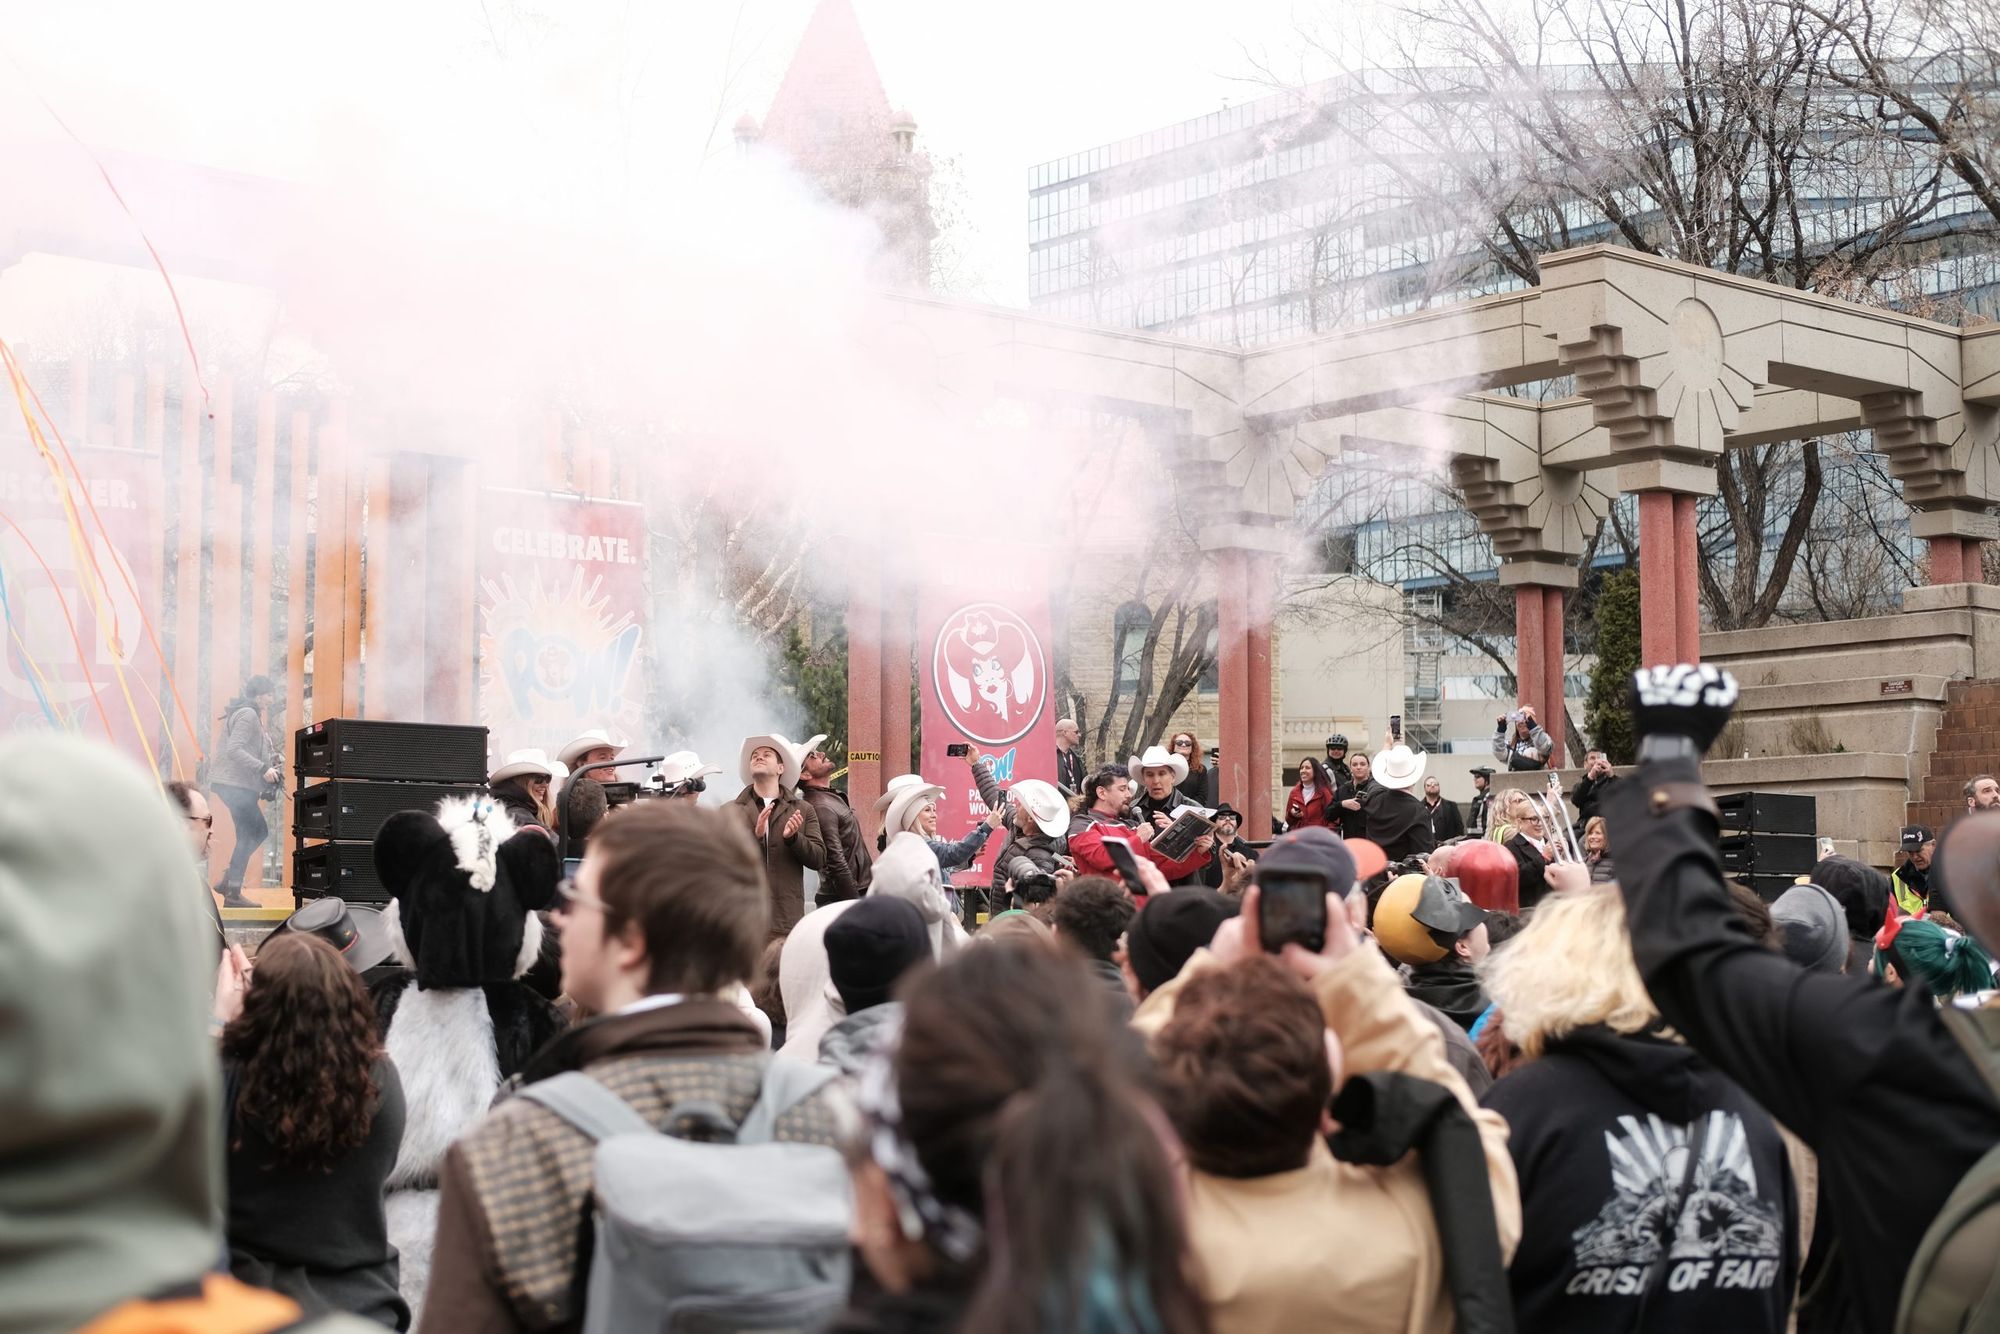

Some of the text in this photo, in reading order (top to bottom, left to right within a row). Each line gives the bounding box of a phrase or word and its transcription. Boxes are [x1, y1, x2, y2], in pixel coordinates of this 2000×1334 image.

[493, 527, 637, 564] CELEBRATE.
[500, 624, 641, 721] POW!
[850, 752, 880, 760] CAUTIO
[979, 747, 1016, 784] OW!
[1566, 1266, 1650, 1295] CRISI
[1668, 1261, 1714, 1291] OF
